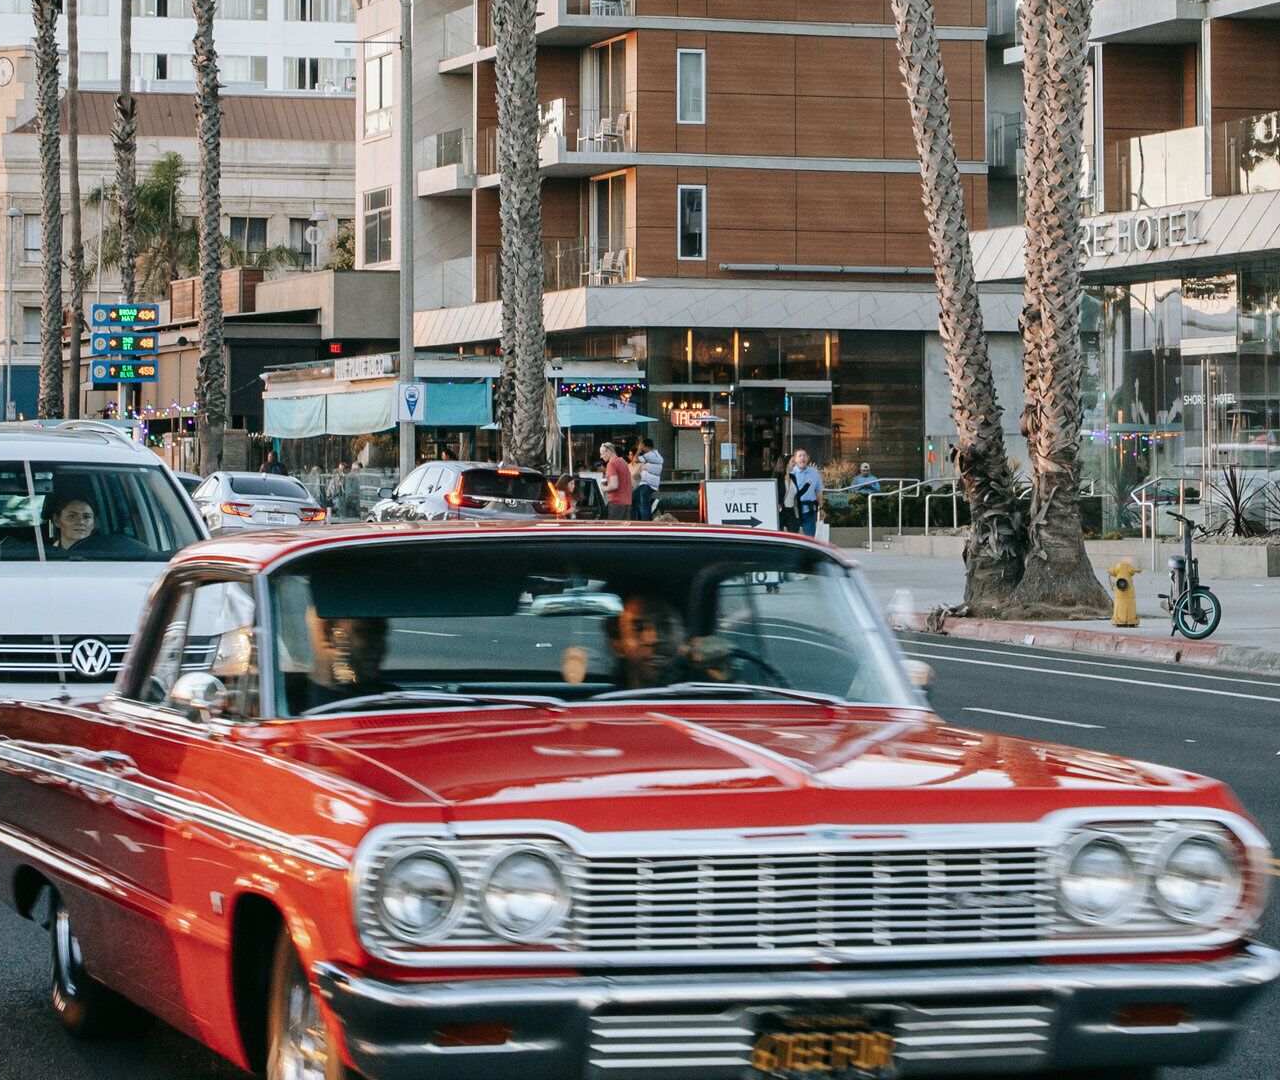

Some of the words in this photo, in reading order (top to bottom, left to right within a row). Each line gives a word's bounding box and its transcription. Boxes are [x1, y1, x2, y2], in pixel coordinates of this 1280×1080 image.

[1117, 209, 1207, 254] HOTEL
[1213, 394, 1237, 404] HOTEL
[725, 503, 758, 513] VALET
